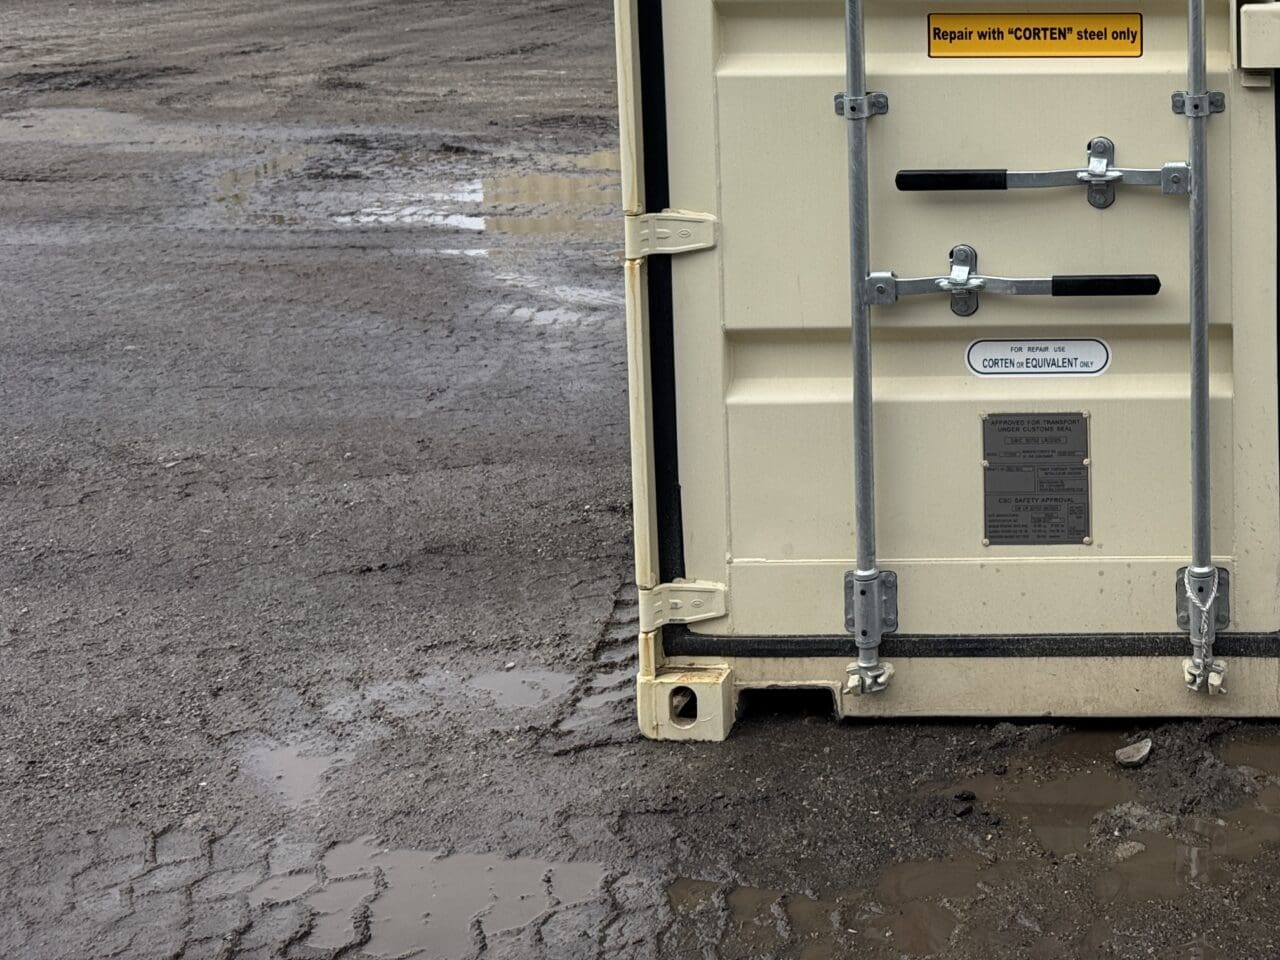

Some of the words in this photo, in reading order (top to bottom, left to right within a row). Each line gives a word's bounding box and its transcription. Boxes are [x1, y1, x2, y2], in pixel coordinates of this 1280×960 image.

[933, 28, 974, 42] Repair
[977, 27, 1004, 40] with
[1076, 27, 1108, 41] steel
[1112, 27, 1138, 43] only
[982, 358, 1015, 368] CORTEN
[1025, 357, 1078, 368] EQUIVALENT
